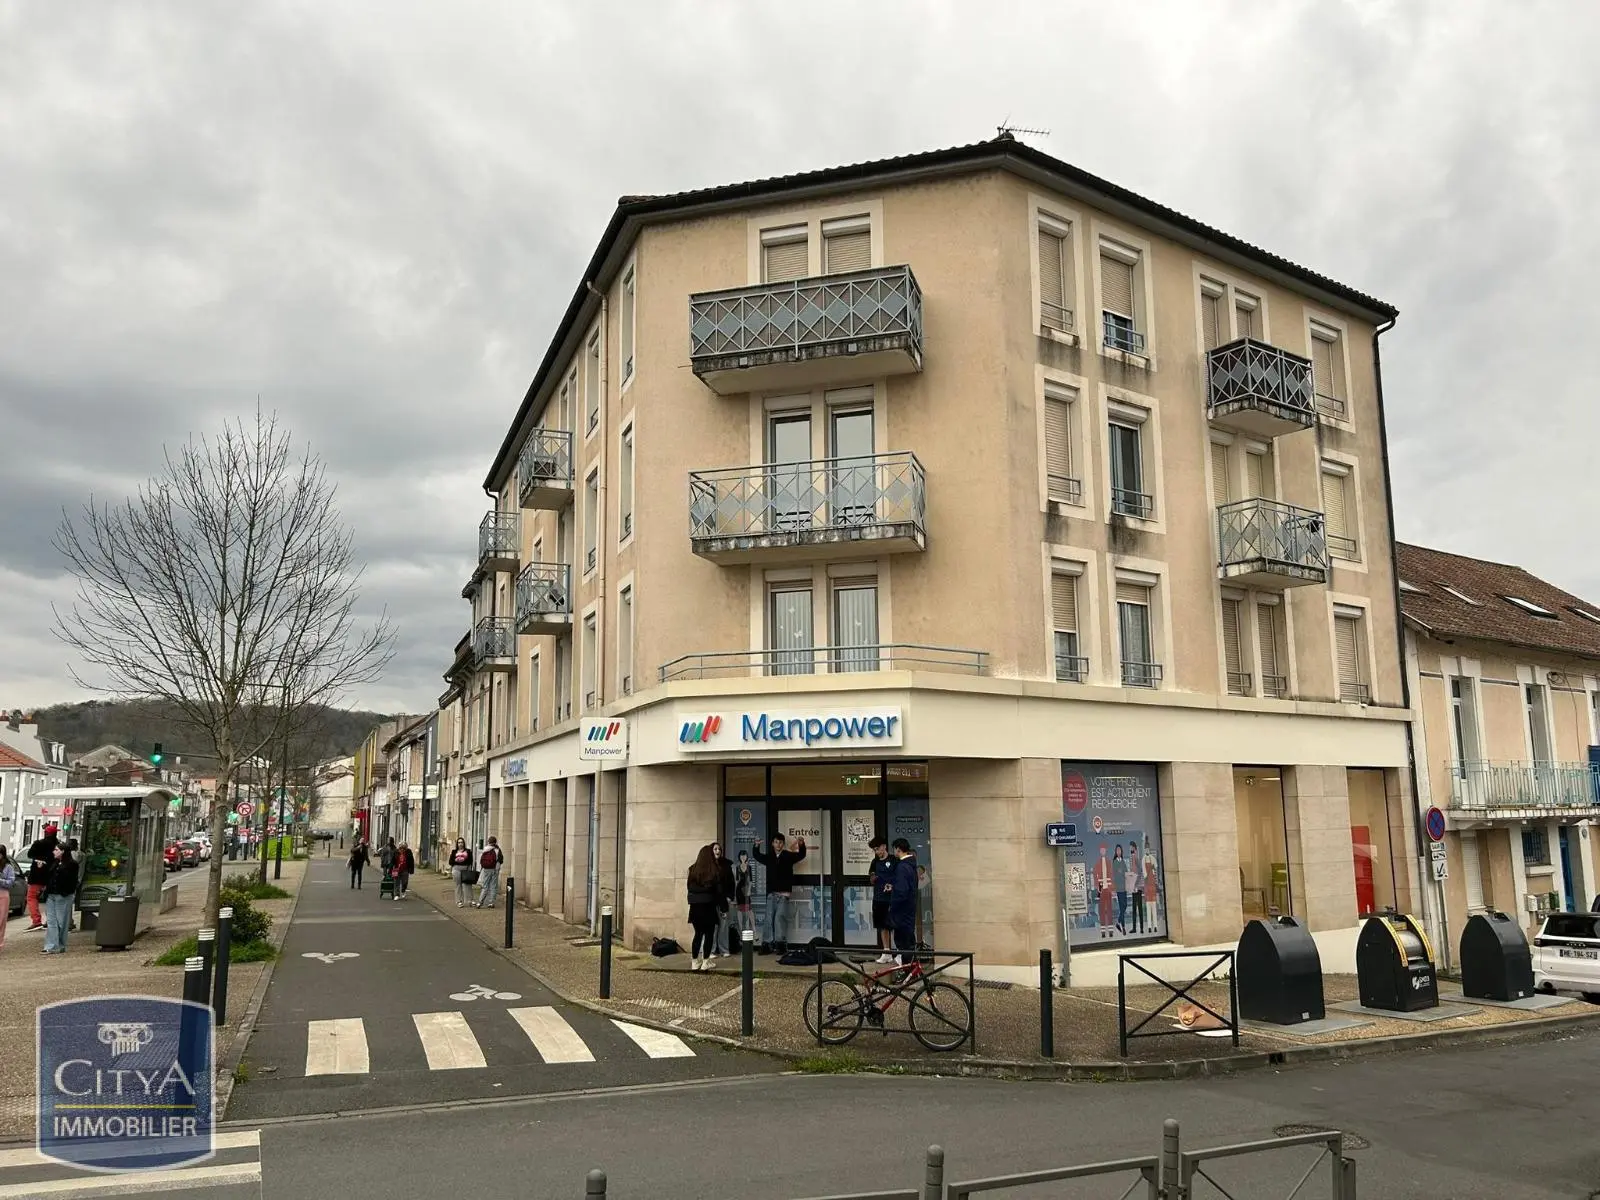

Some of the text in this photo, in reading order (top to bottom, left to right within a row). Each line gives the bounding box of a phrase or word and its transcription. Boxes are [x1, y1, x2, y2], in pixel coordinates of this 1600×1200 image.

[742, 712, 898, 747] Manpower
[584, 747, 622, 755] Manpower
[1091, 787, 1106, 798] EST
[1107, 787, 1152, 798] ACTIVEMENT
[788, 826, 820, 837] Entrée
